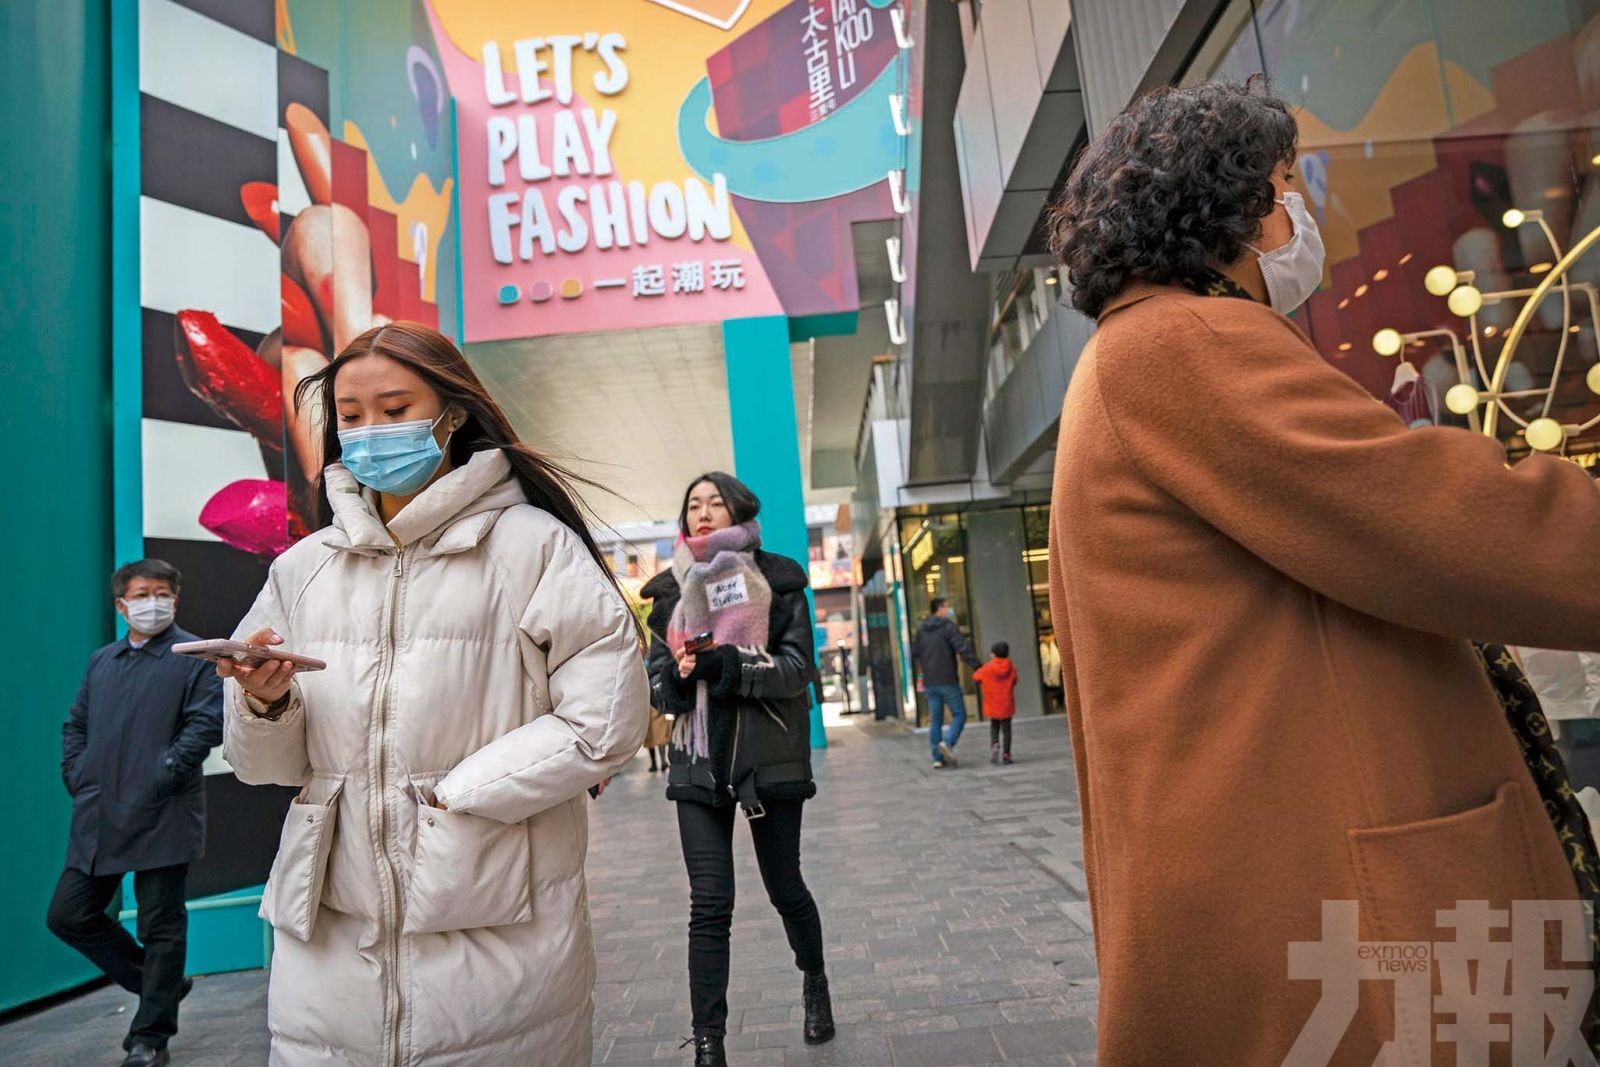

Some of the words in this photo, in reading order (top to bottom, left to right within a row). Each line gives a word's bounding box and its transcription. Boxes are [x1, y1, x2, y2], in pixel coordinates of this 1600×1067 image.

[482, 32, 629, 107] LET'S
[801, 6, 835, 110] 太古里
[834, 8, 873, 57] KOO
[838, 51, 856, 90] LI
[487, 107, 616, 187] PLAY
[487, 173, 732, 265] FASHION
[593, 258, 745, 298] 一起潮玩
